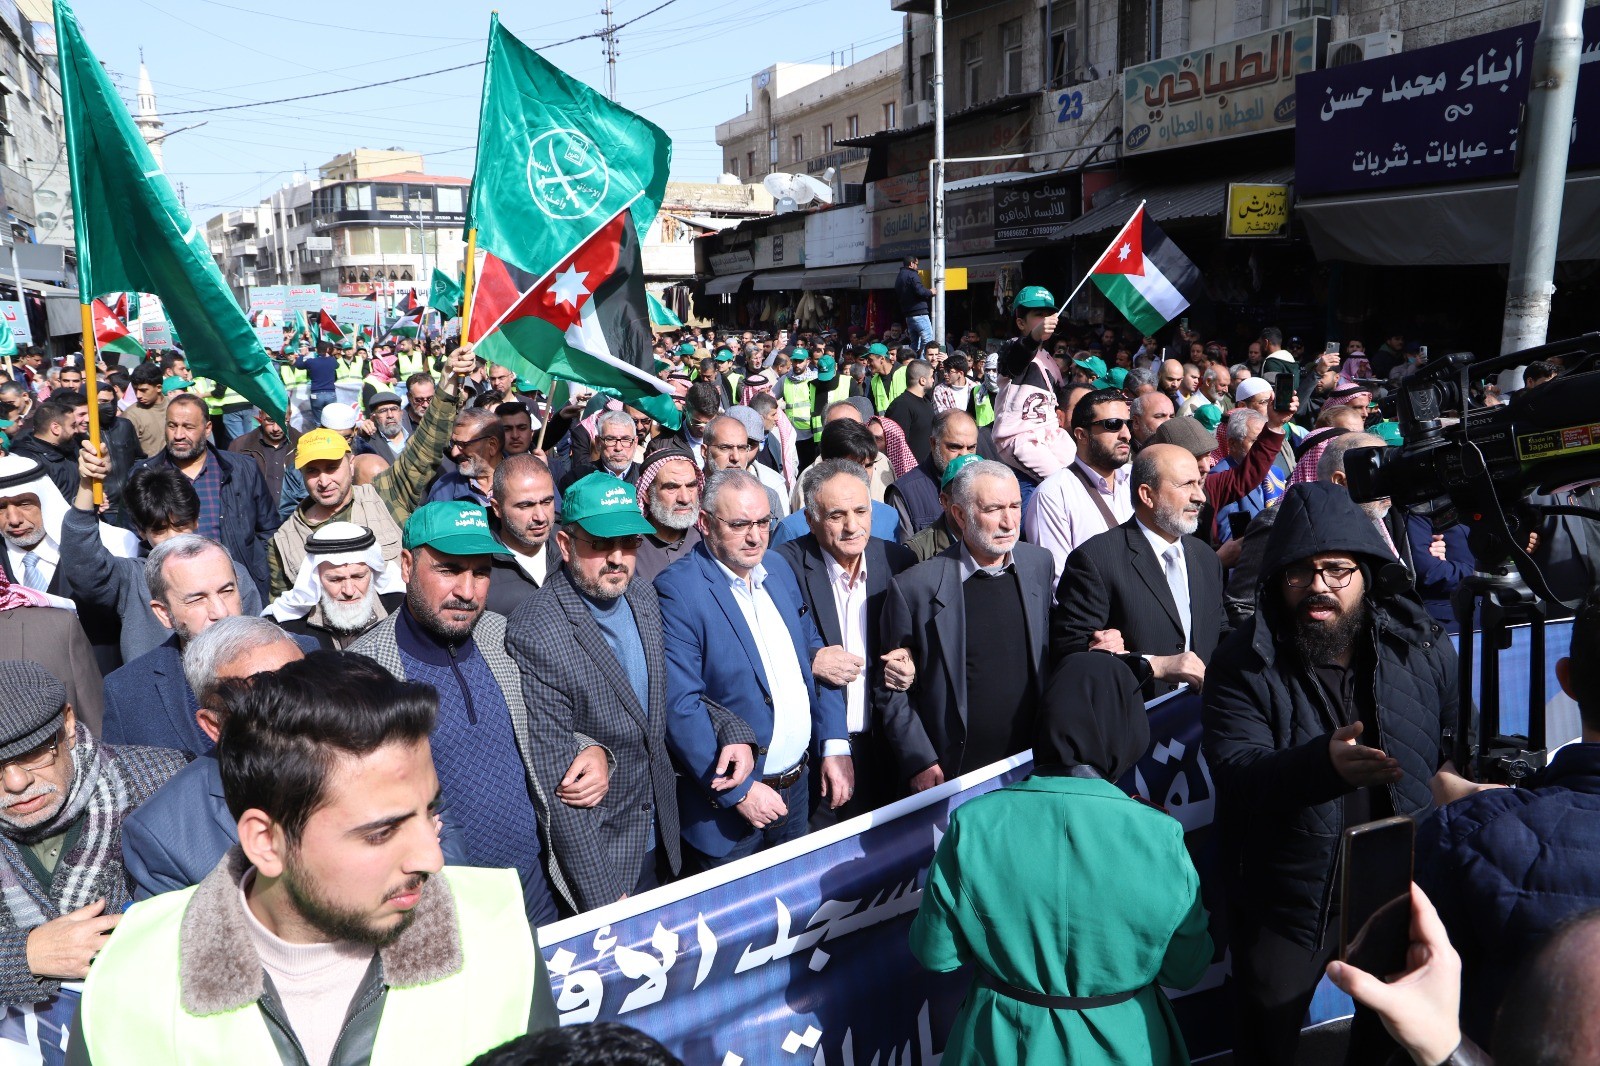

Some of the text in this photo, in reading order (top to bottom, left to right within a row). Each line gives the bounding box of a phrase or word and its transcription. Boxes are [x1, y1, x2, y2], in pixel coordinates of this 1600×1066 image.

[1144, 29, 1293, 121] الطباخي
[1320, 37, 1523, 122] أبناء محمد حسن
[1058, 90, 1084, 123] 23
[1219, 98, 1265, 132] للعطور
[1206, 117, 1214, 131] و
[1352, 139, 1488, 177] عبايات نثريات
[884, 212, 913, 238] الفاروق
[1466, 417, 1494, 427] SONY
[1529, 442, 1554, 451] Japan
